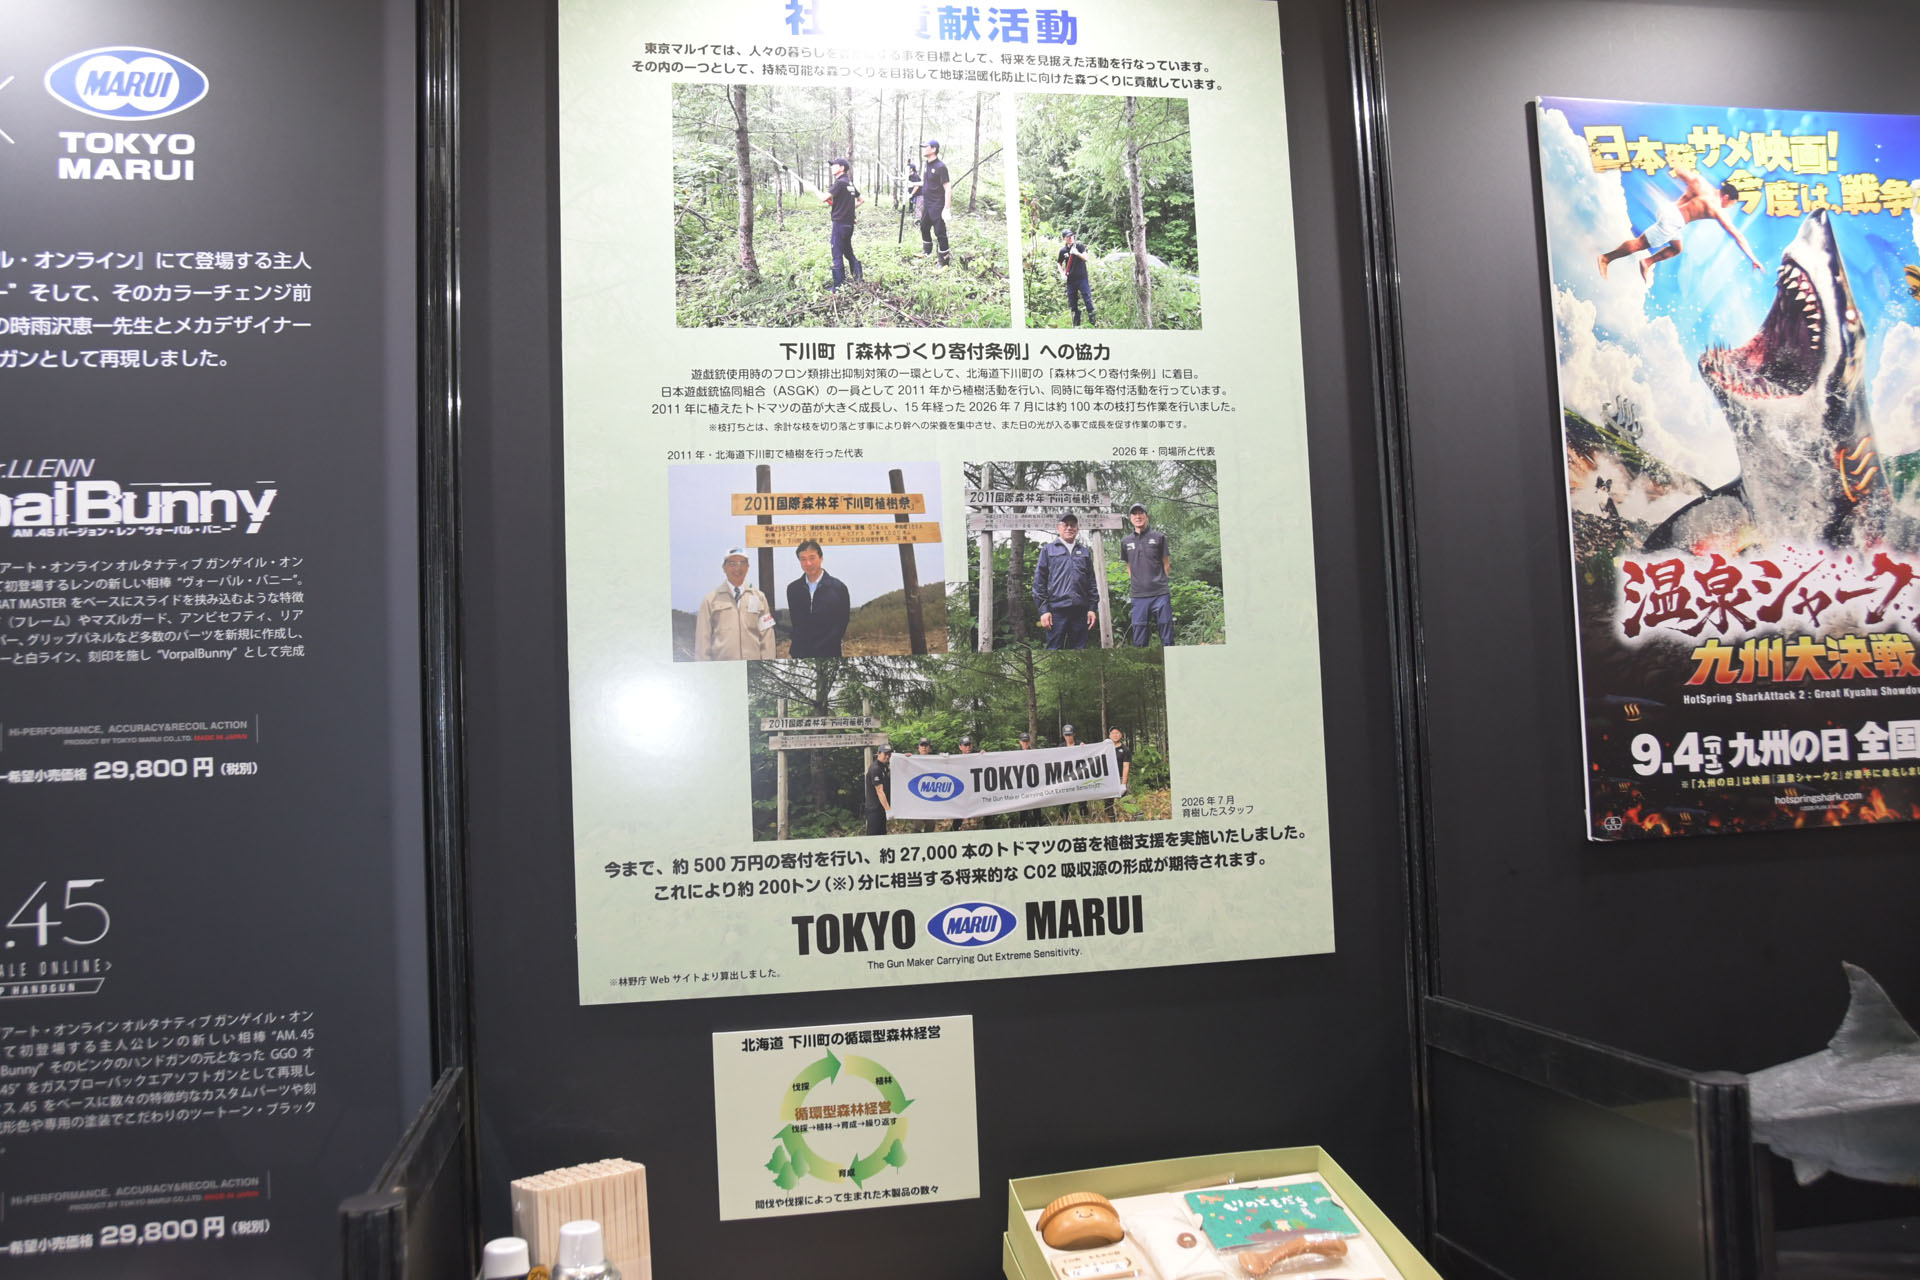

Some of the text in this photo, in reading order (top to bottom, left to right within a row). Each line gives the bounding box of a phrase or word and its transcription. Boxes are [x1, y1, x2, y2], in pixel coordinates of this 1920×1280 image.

[785, 0, 1078, 46] 社献活動
[84, 70, 173, 98] MARUI
[59, 131, 195, 155] TOKYO
[58, 158, 194, 181] MARUI
[780, 342, 1110, 361] 下川町「森林づくり寄付条例」への協力
[19, 597, 66, 609] MASTER
[1622, 553, 1920, 638] 温泉シャーク
[1684, 632, 1920, 685] 九州大決戦
[1684, 693, 1732, 705] HotSpring
[1736, 691, 1795, 702] SharkAttack
[1798, 690, 1804, 699] 2
[1814, 688, 1841, 699] Great
[1843, 687, 1878, 699] Kyushu
[210, 720, 248, 731] ACTION
[1630, 732, 1704, 776] 9.4
[1728, 728, 1849, 768] 九州の日
[1854, 720, 1920, 762] 全国
[920, 754, 1109, 794] MARUI TOKYO MARUI
[1774, 791, 1863, 806] hotspringshark.com
[1182, 804, 1254, 819] 育樹したスタッフ
[791, 895, 1144, 956] TOKYO MARUI MARUI
[868, 947, 1083, 969] The Gun Maker Carrying Out Extreme Sensitivity.
[12, 983, 76, 995] HANDGUN
[741, 1025, 941, 1052] 北海道 下川町の循環型森林経営
[271, 1047, 297, 1060] GGO
[794, 1100, 892, 1121] 循環型森林経営
[221, 1176, 259, 1189] ACTION
[755, 1184, 940, 1210] 間伐や伐採によって生まれた木製品の数々
